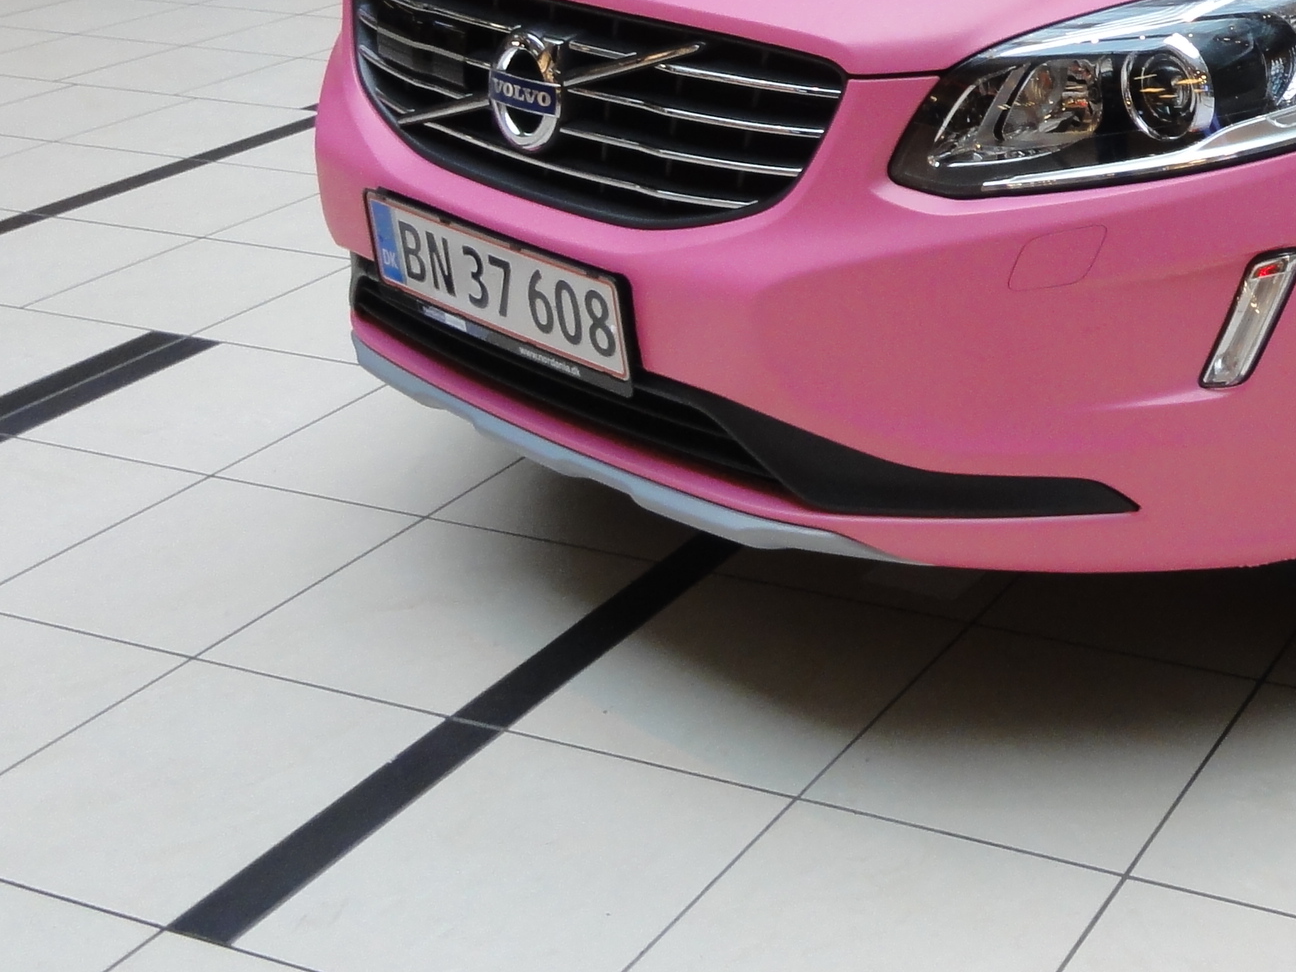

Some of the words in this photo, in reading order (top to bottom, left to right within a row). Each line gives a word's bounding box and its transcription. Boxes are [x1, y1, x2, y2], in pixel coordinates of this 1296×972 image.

[492, 78, 552, 108] VOLVO
[382, 248, 399, 270] DK
[398, 220, 457, 298] BN
[462, 245, 512, 318] 37
[528, 269, 617, 358] 608
